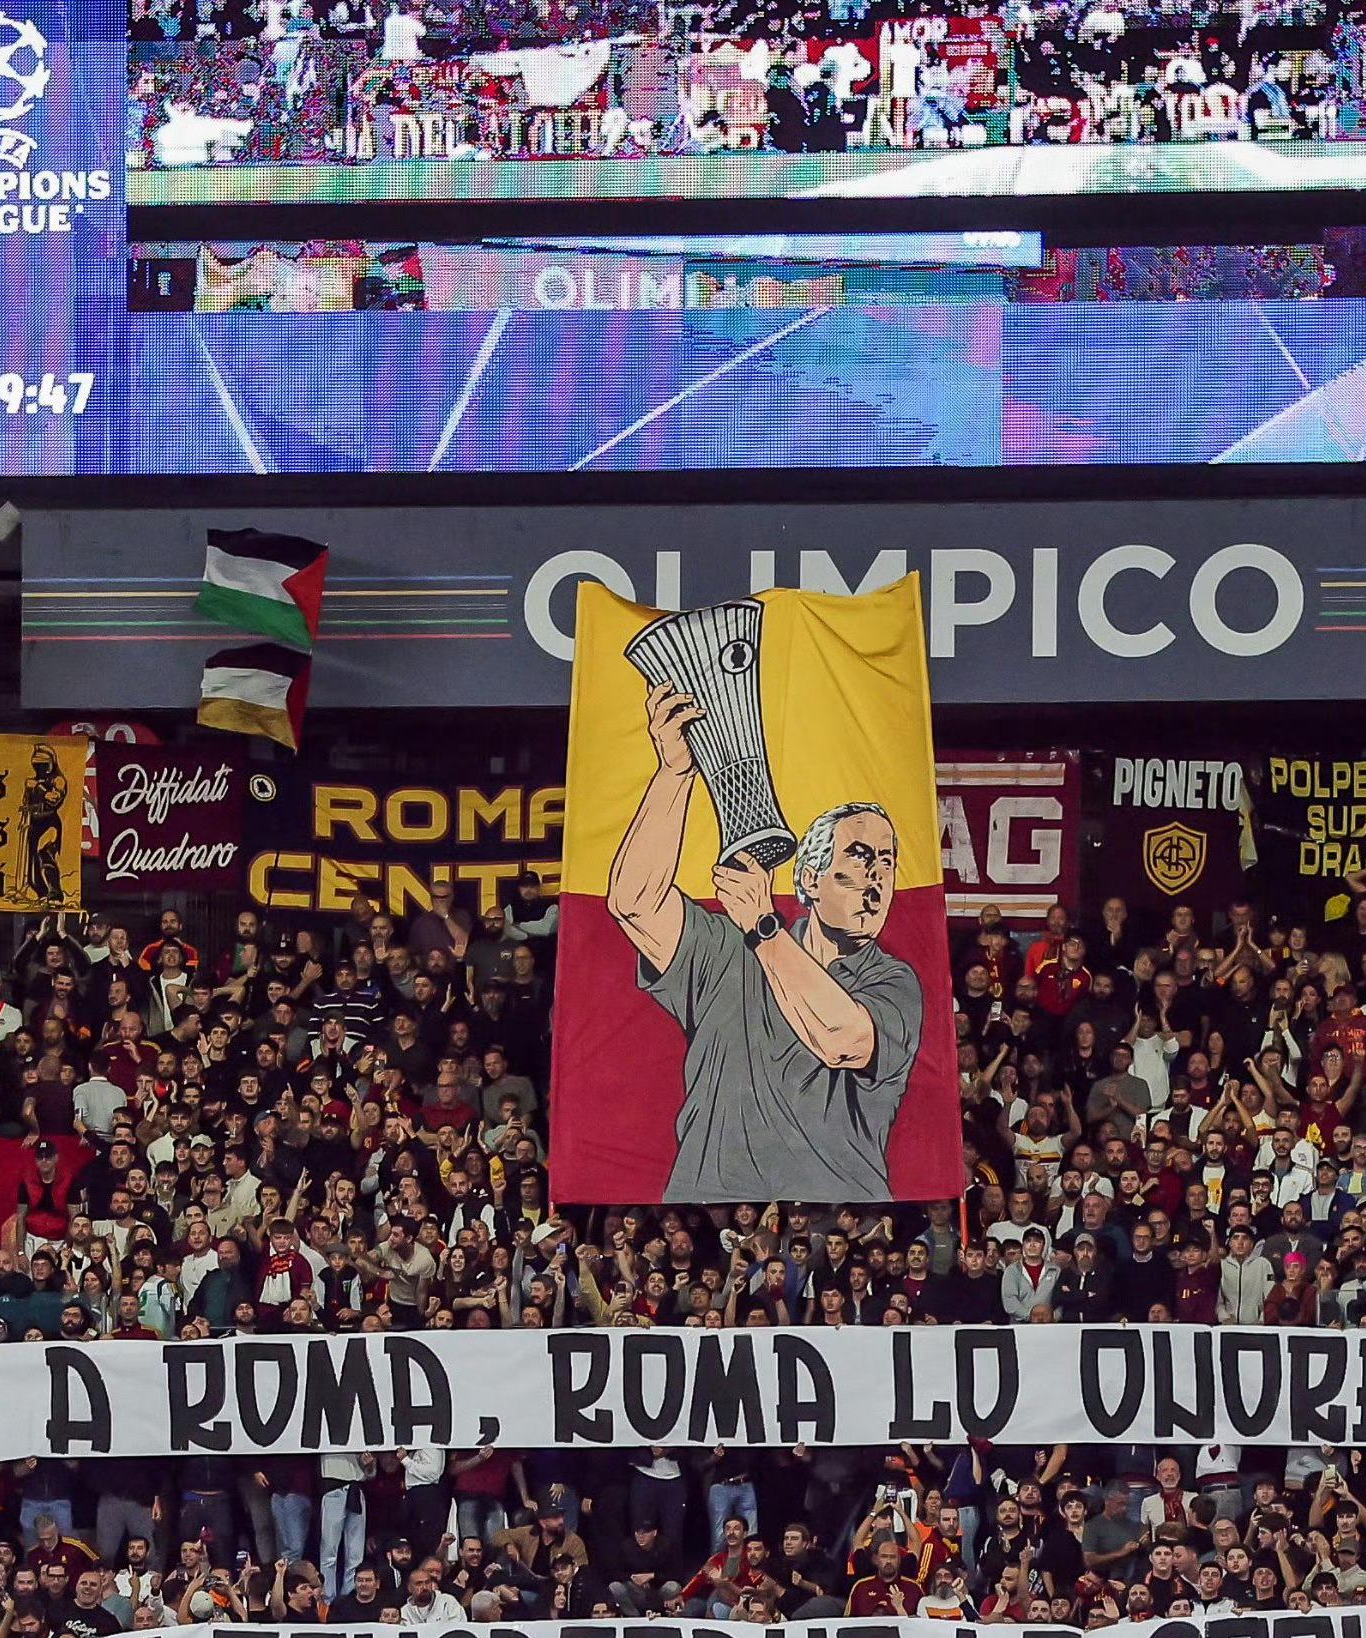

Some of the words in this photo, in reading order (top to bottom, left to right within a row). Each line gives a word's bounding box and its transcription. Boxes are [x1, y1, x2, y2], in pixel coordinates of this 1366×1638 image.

[110, 763, 233, 824] Diffidati
[1114, 757, 1244, 811] PIGNETO
[106, 828, 238, 882] Quadraro
[45, 1346, 111, 1454] A
[547, 1333, 835, 1444] ROMA
[889, 1330, 1022, 1441] LO
